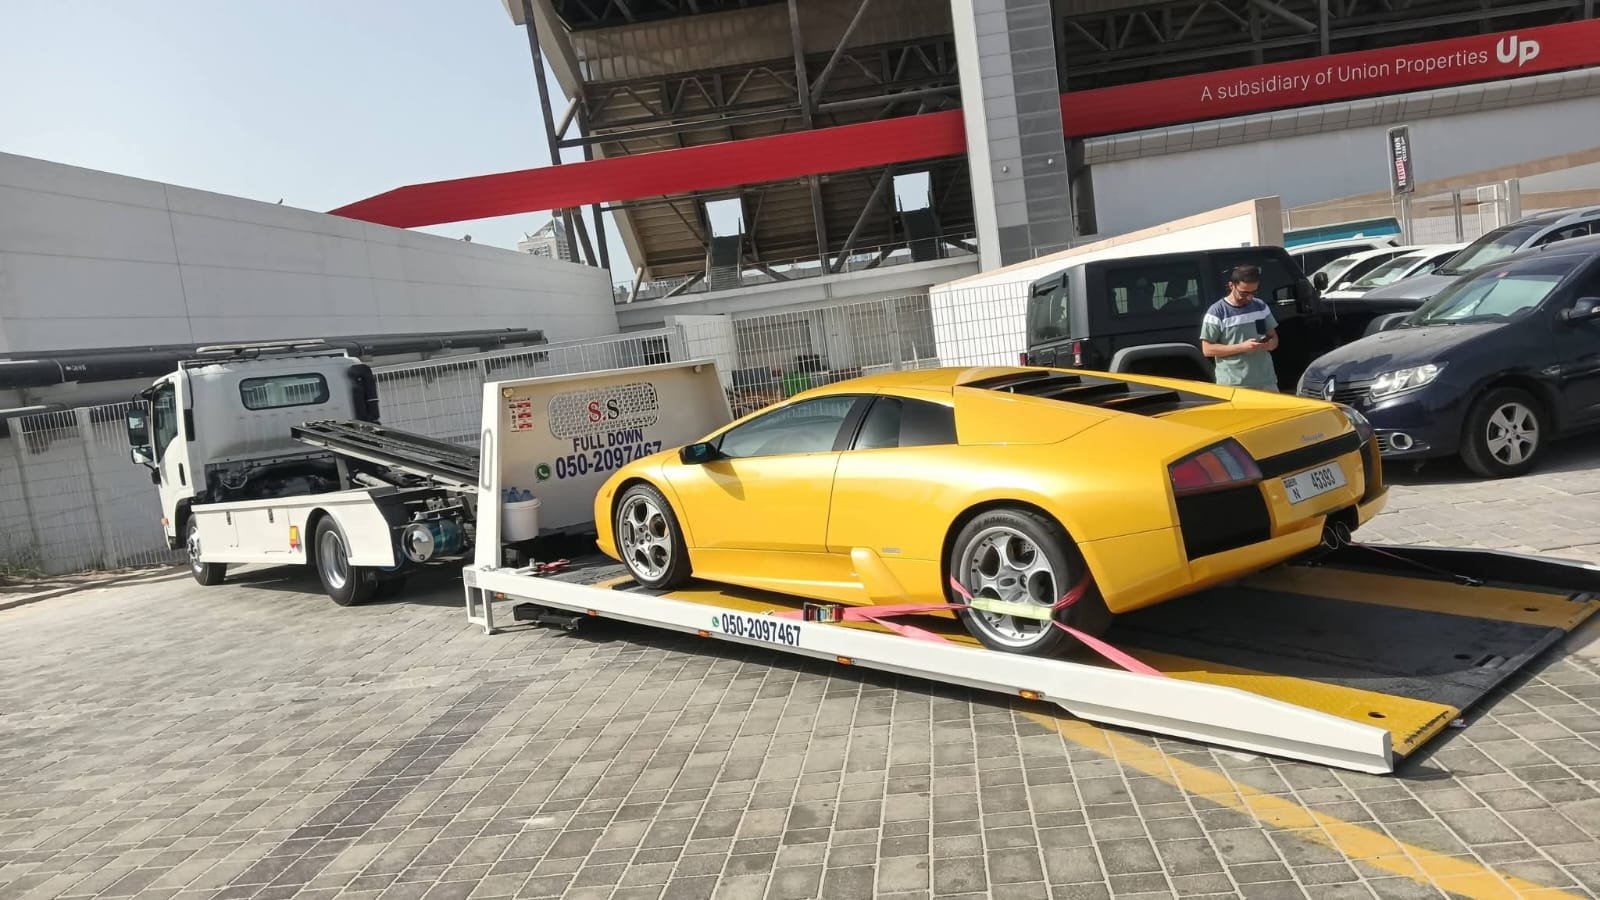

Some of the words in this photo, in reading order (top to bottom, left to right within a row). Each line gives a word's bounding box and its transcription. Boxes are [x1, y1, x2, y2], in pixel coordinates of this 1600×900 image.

[1200, 86, 1213, 102] A
[1217, 75, 1311, 100] subsidiary
[1315, 67, 1333, 86] of
[1338, 63, 1390, 82] Union
[1395, 50, 1488, 75] Properties
[573, 433, 605, 453] FULL
[607, 429, 643, 447] DOWN
[1310, 468, 1336, 490] 45393
[722, 613, 801, 647] 050-2097467
